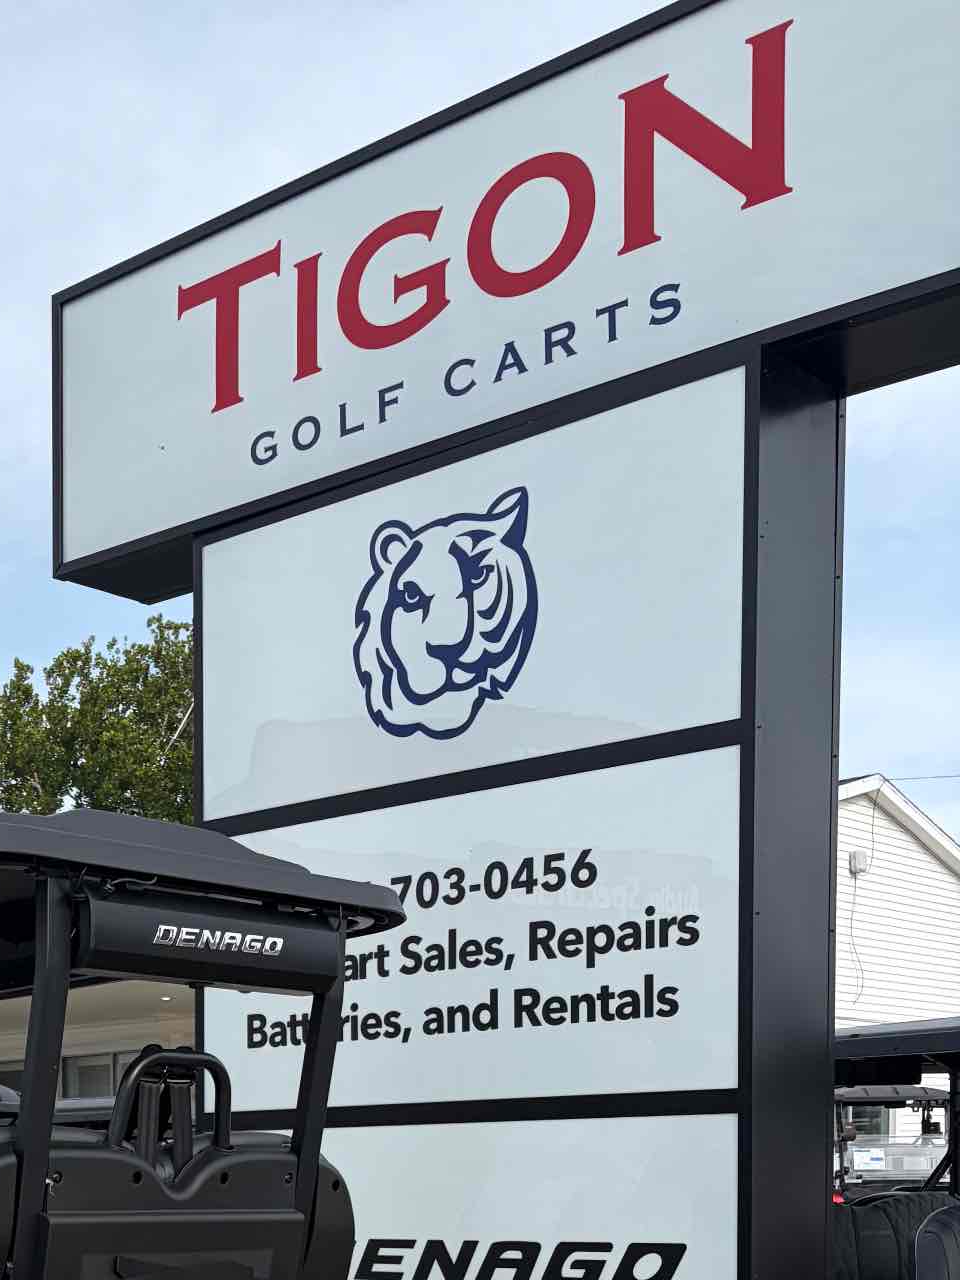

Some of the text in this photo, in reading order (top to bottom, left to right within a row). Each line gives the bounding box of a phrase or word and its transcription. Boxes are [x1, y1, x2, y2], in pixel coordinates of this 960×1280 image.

[177, 18, 794, 413] TIGON
[250, 283, 681, 466] GOLF CARTS
[389, 848, 599, 909] 703-0456
[152, 924, 284, 956] DENAGO
[344, 905, 701, 982] art Sales, Repairs
[246, 974, 680, 1049] Battries, and Rentals
